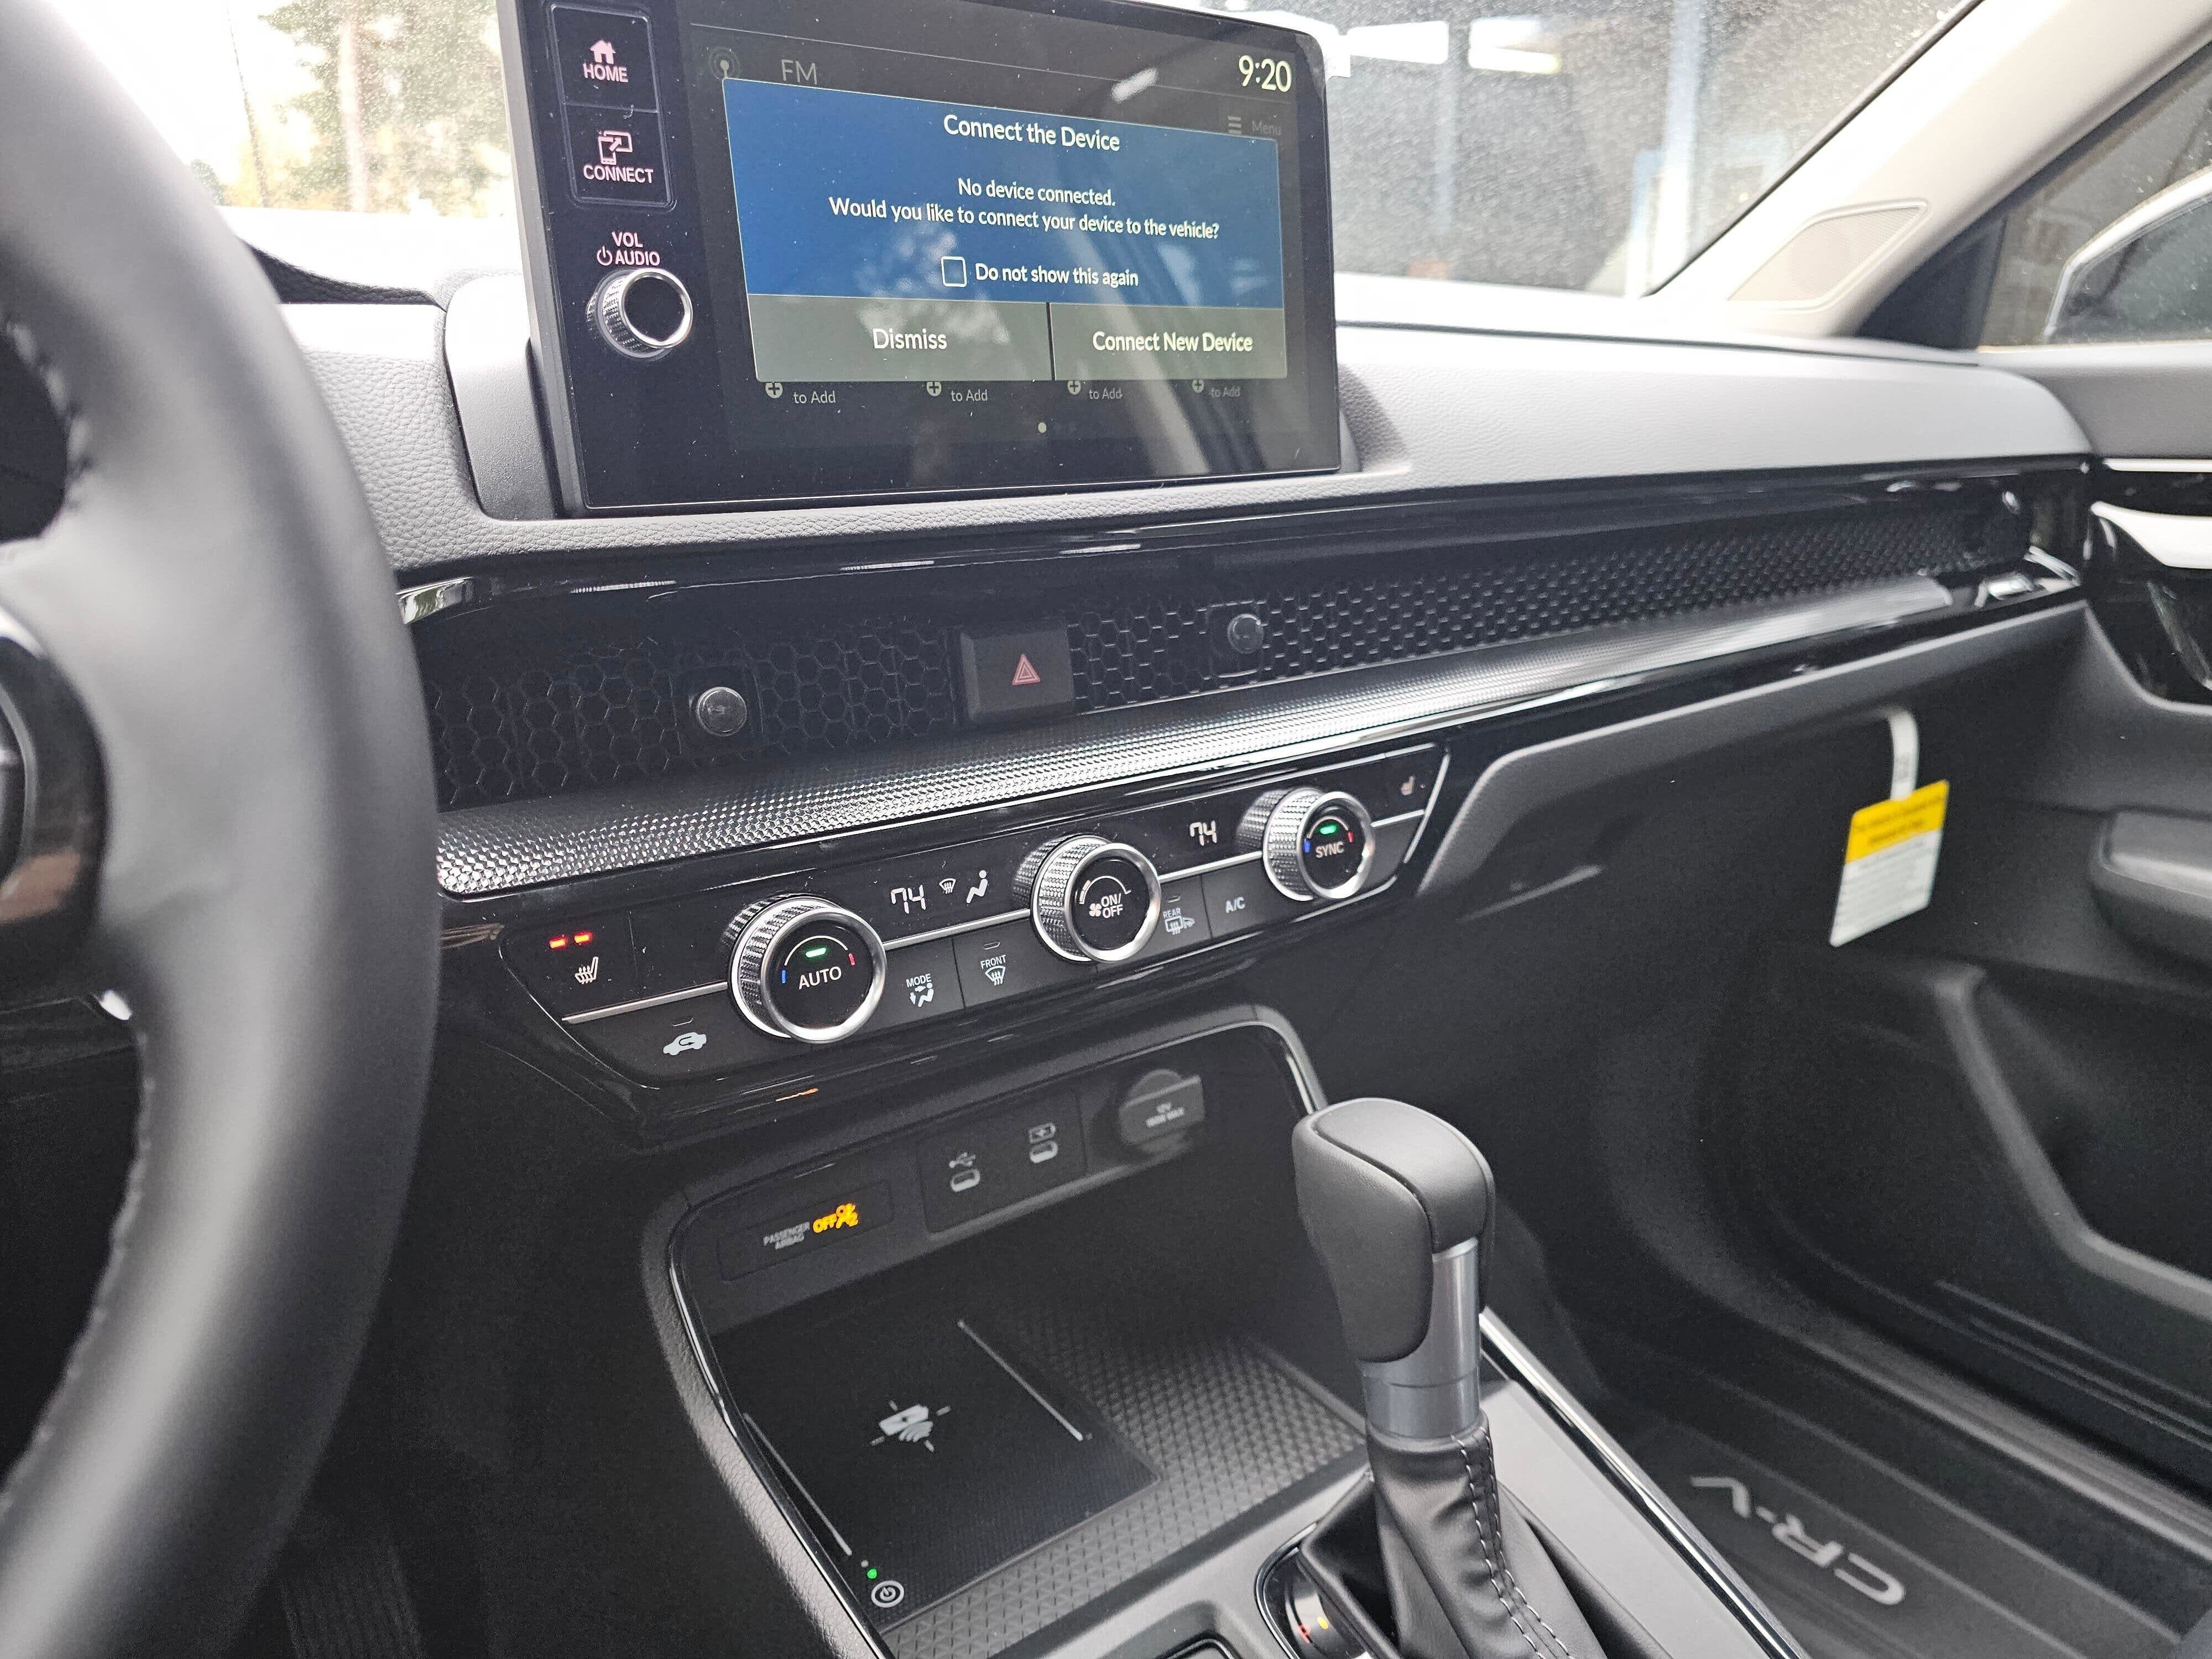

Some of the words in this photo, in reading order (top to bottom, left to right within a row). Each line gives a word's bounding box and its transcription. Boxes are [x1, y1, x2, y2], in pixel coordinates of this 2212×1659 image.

[583, 65, 628, 82] HOME
[781, 59, 818, 85] FM
[1239, 55, 1291, 92] 9:20
[944, 115, 1022, 141] Connect
[1026, 123, 1056, 144] the
[1061, 127, 1119, 151] Device
[1252, 121, 1281, 135] Menu
[583, 165, 654, 184] CONNECT
[958, 178, 981, 196] No
[987, 180, 1034, 200] device
[1038, 189, 1115, 206] connected.
[829, 197, 886, 217] Would
[891, 206, 921, 222] you
[927, 204, 953, 222] like
[957, 207, 974, 223] to
[979, 212, 1039, 227] connect
[1042, 216, 1075, 231] your
[1079, 214, 1123, 233] device
[1126, 218, 1141, 234] to
[1144, 219, 1166, 235] the
[1169, 221, 1219, 238] vehicle?
[612, 232, 643, 247] VOL
[615, 251, 660, 267] AUDIO
[975, 263, 998, 280] Do
[1003, 266, 1027, 281] not
[1031, 265, 1070, 283] show
[1073, 268, 1099, 284] this
[1103, 269, 1138, 288] again
[873, 328, 947, 349] Dismiss
[1093, 332, 1160, 351] Connect
[1164, 332, 1198, 351] New
[1203, 333, 1252, 351] Device
[794, 393, 807, 403] to
[811, 390, 836, 403] Add
[951, 391, 962, 401] to
[966, 389, 988, 401] Add
[1089, 389, 1100, 399] to
[1103, 388, 1123, 399] Add
[1211, 388, 1220, 398] to
[1223, 387, 1240, 397] Add
[1190, 821, 1217, 846] 74
[1316, 842, 1343, 857] SYNC
[891, 885, 926, 914] 74
[1226, 897, 1245, 912] A/C
[1102, 904, 1123, 919] OFF
[1163, 907, 1181, 919] REAR
[980, 954, 1006, 969] FRONT
[799, 967, 841, 989] AUTO
[906, 974, 932, 988] MODE
[813, 1213, 837, 1233] OFF
[1690, 1476, 1905, 1605] CR-V
